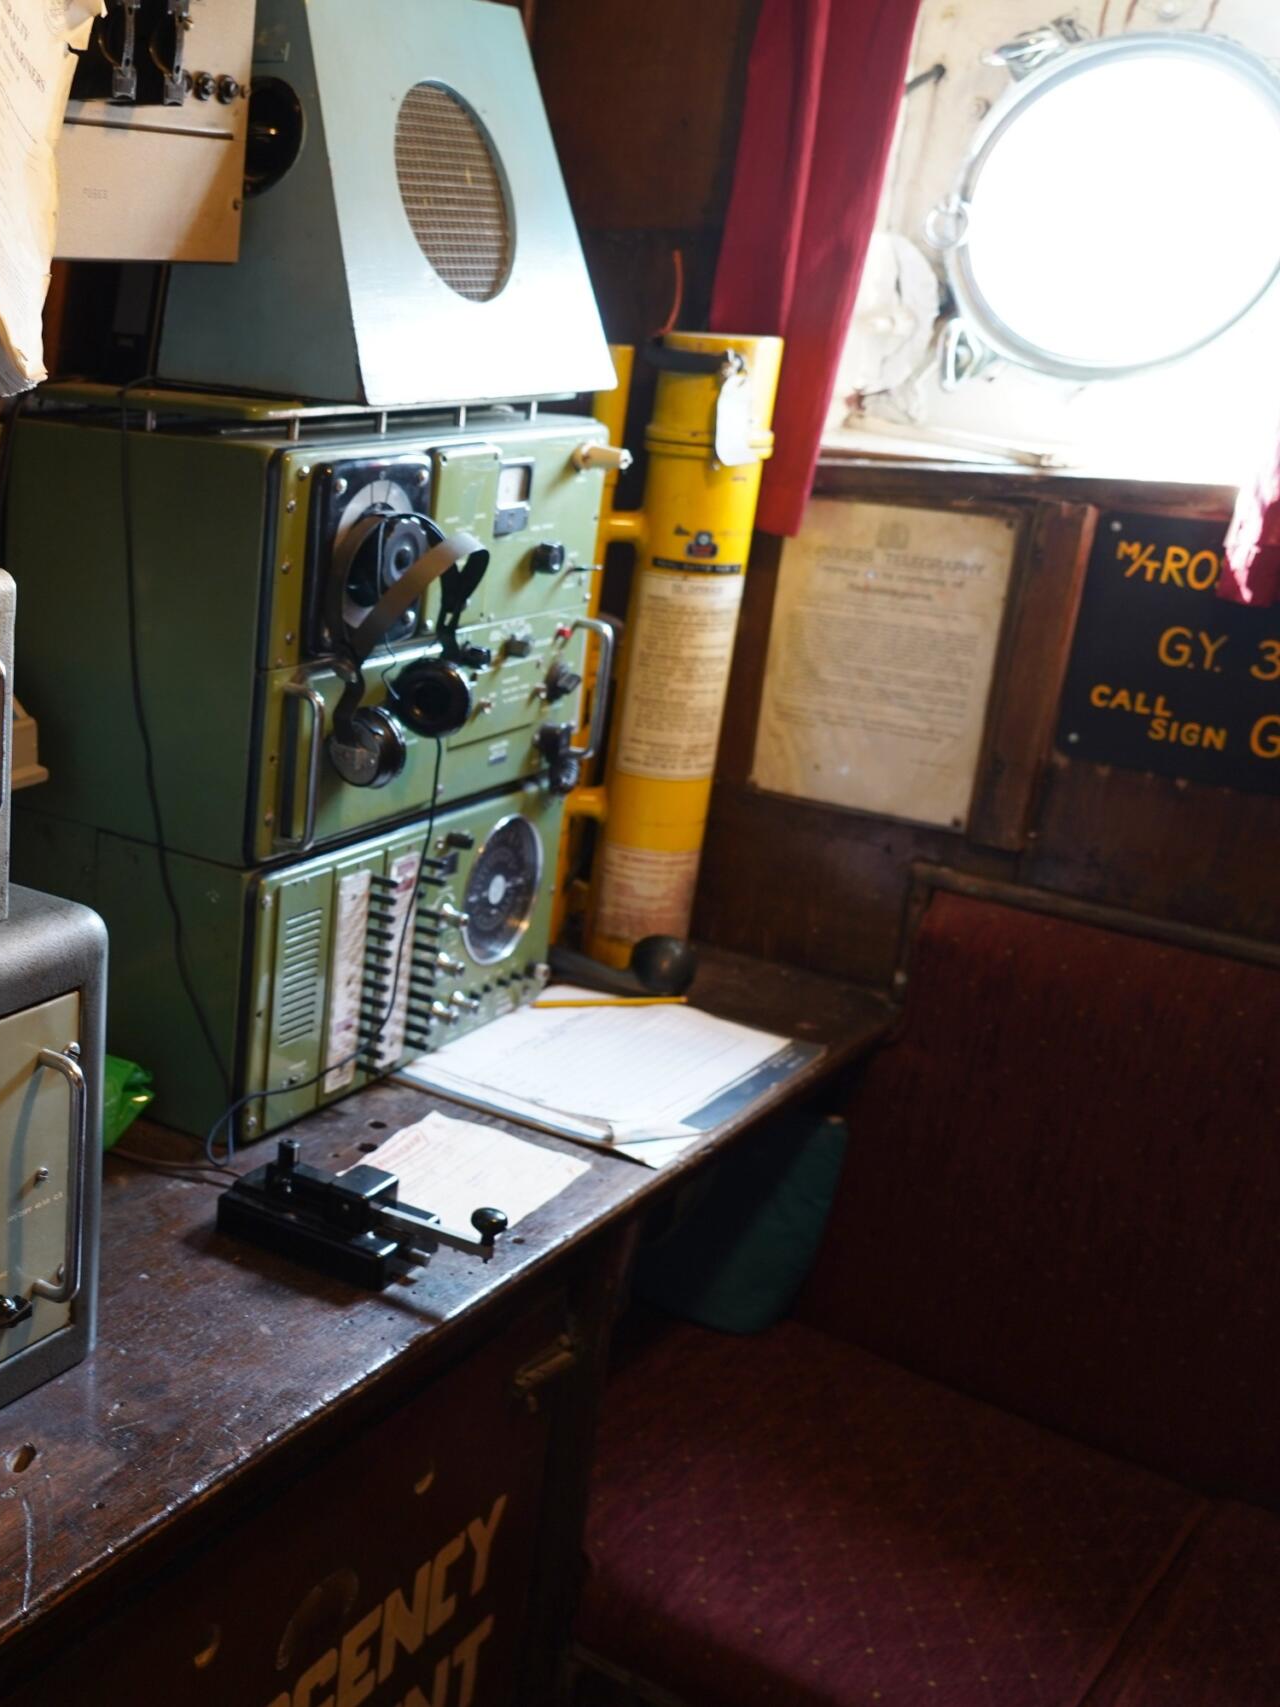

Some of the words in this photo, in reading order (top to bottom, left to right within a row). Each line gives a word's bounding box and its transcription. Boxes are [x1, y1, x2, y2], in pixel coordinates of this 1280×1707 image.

[1160, 545, 1220, 592] RO
[1158, 625, 1228, 673] G.Y.
[1090, 684, 1173, 717] CALL
[1147, 717, 1228, 751] SIGN
[265, 1494, 508, 1707] GENCY
